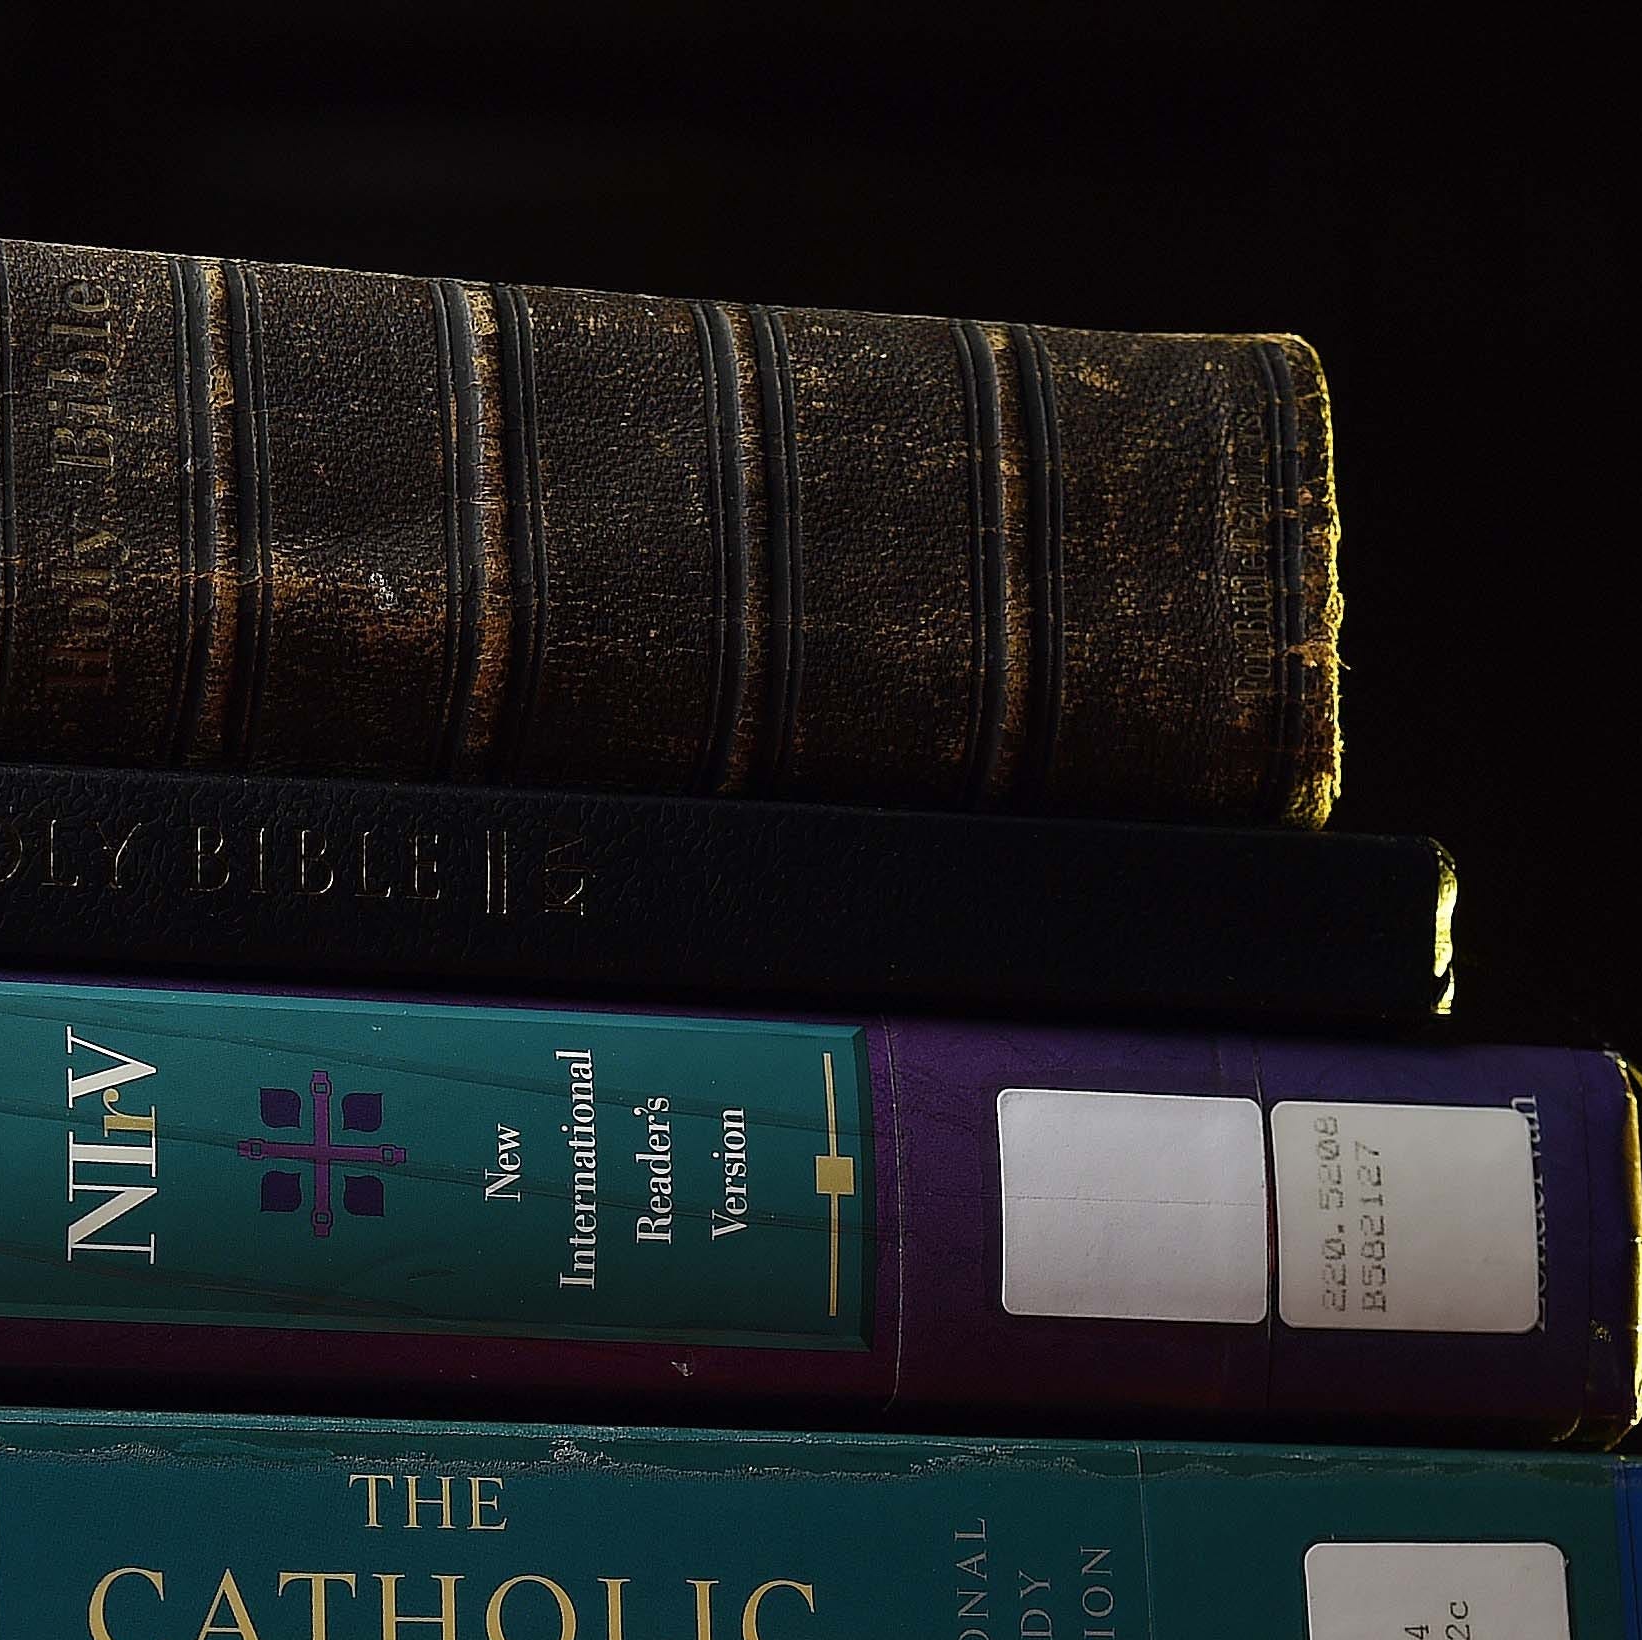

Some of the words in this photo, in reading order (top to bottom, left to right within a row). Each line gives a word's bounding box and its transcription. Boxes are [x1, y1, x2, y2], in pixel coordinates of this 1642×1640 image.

[49, 274, 114, 469] Bible
[1231, 554, 1271, 642] Bible
[185, 823, 442, 900] BIBLE
[66, 1025, 159, 1265] NIrV
[484, 1122, 521, 1202] New
[554, 1048, 598, 1291] International
[633, 1093, 674, 1245] Reader's
[710, 1106, 749, 1240] Version
[1355, 1141, 1386, 1313] B582127
[349, 1474, 508, 1532] THE
